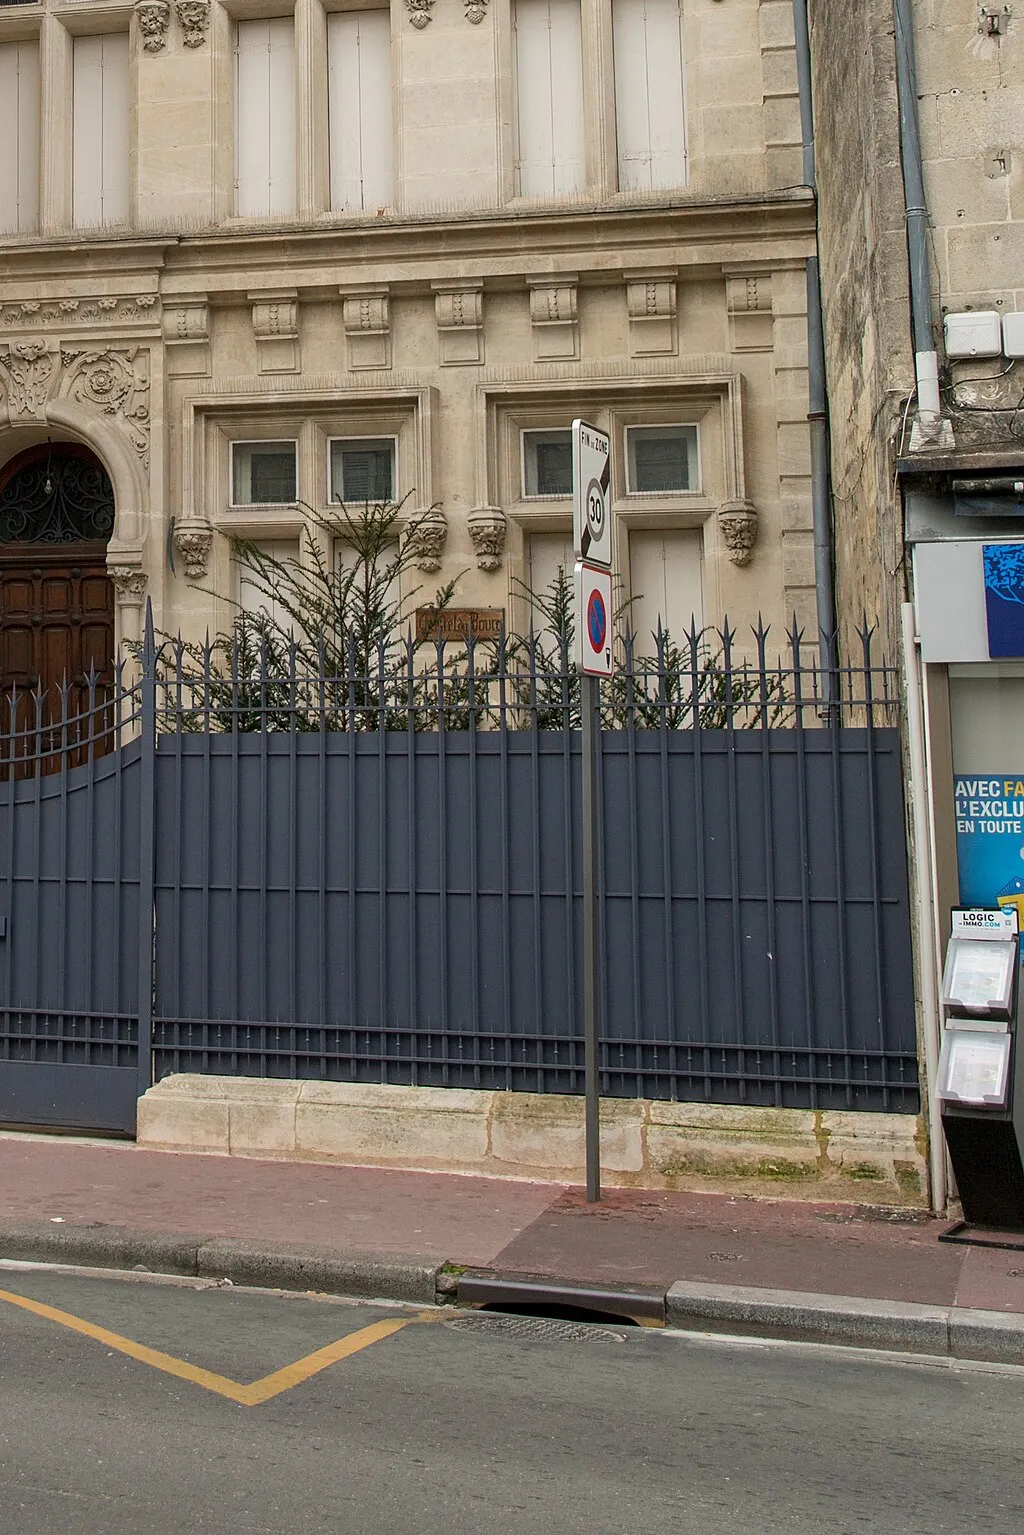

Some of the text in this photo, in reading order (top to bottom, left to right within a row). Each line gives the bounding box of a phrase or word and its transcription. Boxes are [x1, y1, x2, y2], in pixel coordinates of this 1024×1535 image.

[581, 431, 590, 447] FIN
[595, 437, 608, 456] ZONE
[589, 495, 602, 524] 30
[418, 612, 458, 632] Ctel
[955, 780, 1024, 797] AVEC FA
[957, 820, 1022, 834] EN TOUTE
[963, 913, 995, 922] LOGIC
